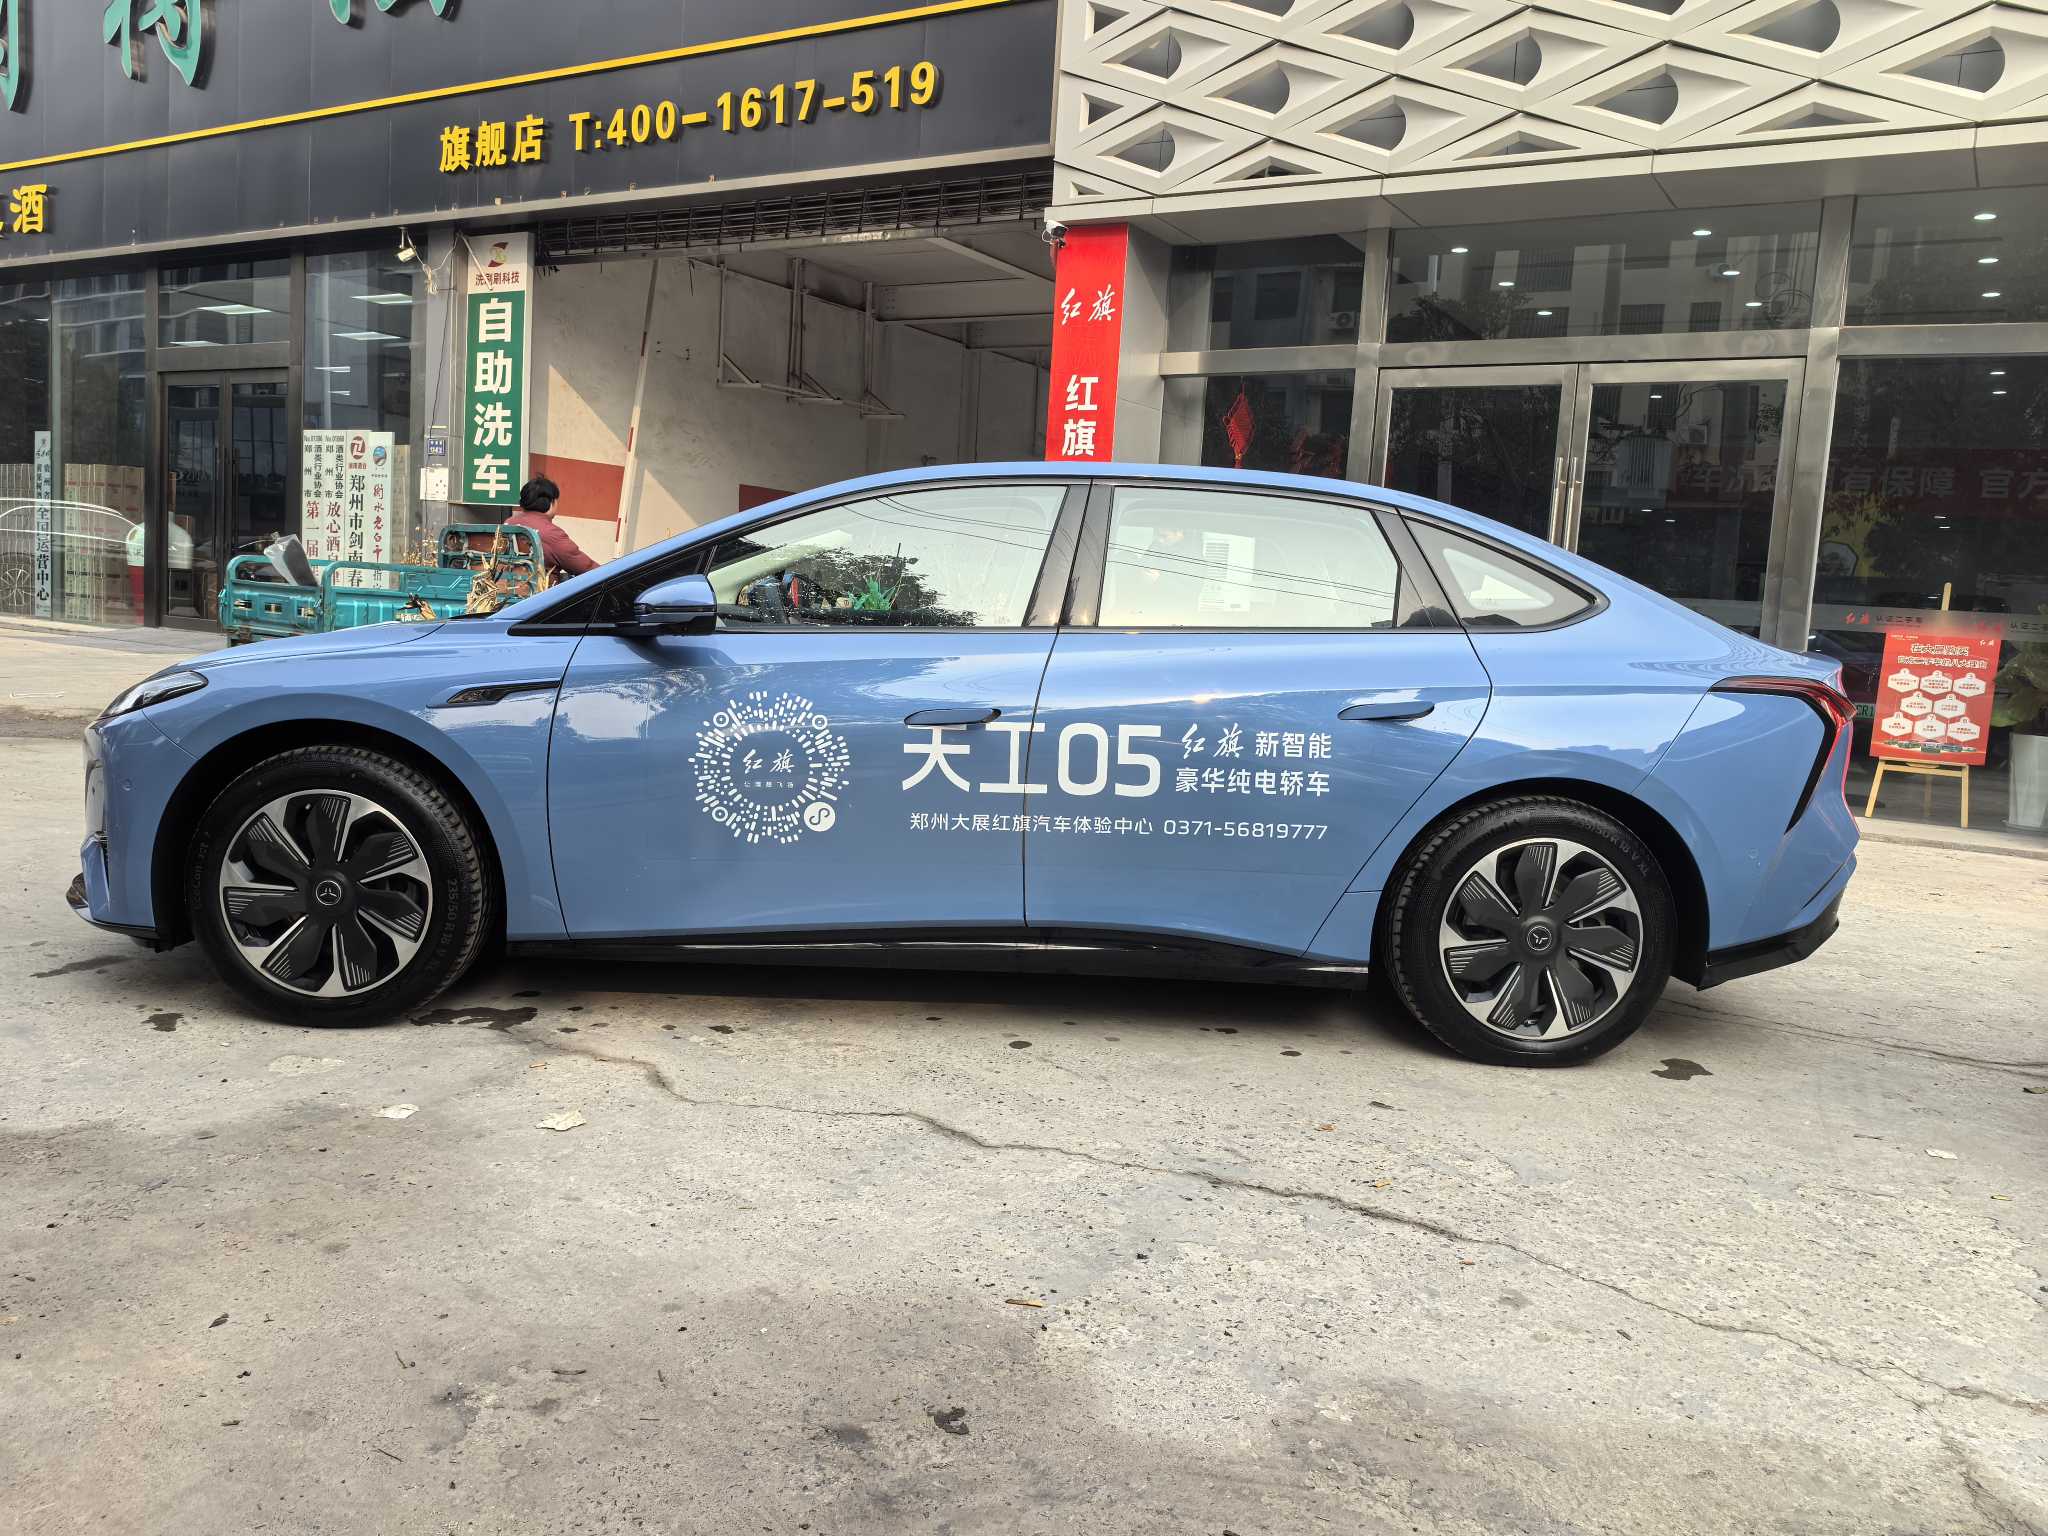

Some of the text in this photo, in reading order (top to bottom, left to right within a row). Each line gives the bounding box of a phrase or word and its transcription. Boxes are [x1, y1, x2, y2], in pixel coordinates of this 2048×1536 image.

[439, 114, 544, 174] 旗舰店
[0, 183, 49, 241] 酒
[475, 271, 520, 287] 洗刷刷科技
[1060, 283, 1117, 326] 红旗
[471, 297, 514, 500] 自助洗车
[1061, 373, 1100, 457] 红旗
[1181, 722, 1332, 760] 红旗 新智能
[743, 749, 796, 774] 红旗
[1175, 767, 1331, 798] 豪华纯电轿车
[909, 812, 1329, 841] 郑州大展红旗汽车体验中心 0371-56819777
